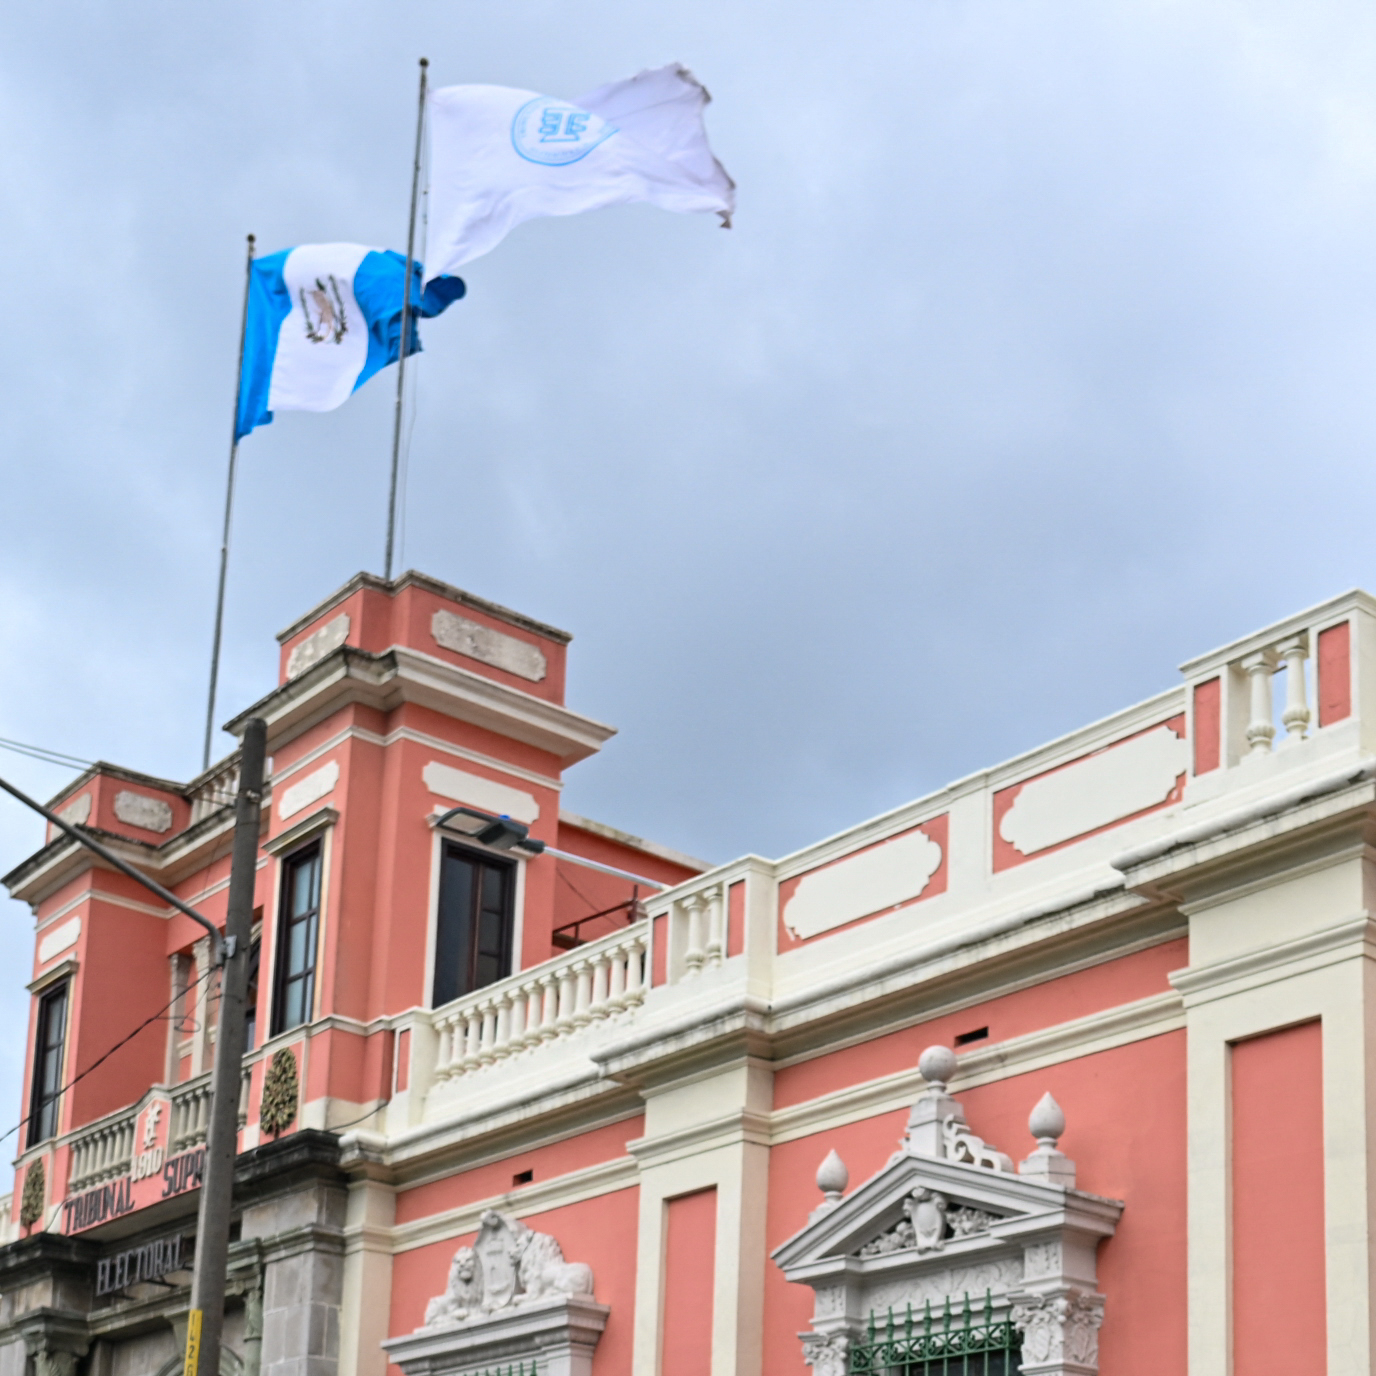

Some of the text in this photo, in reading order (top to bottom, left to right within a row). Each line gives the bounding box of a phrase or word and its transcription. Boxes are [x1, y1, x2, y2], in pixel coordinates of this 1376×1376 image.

[64, 1149, 206, 1235] TRIBUNAL SUPR
[96, 1234, 186, 1297] ELECTORAL
